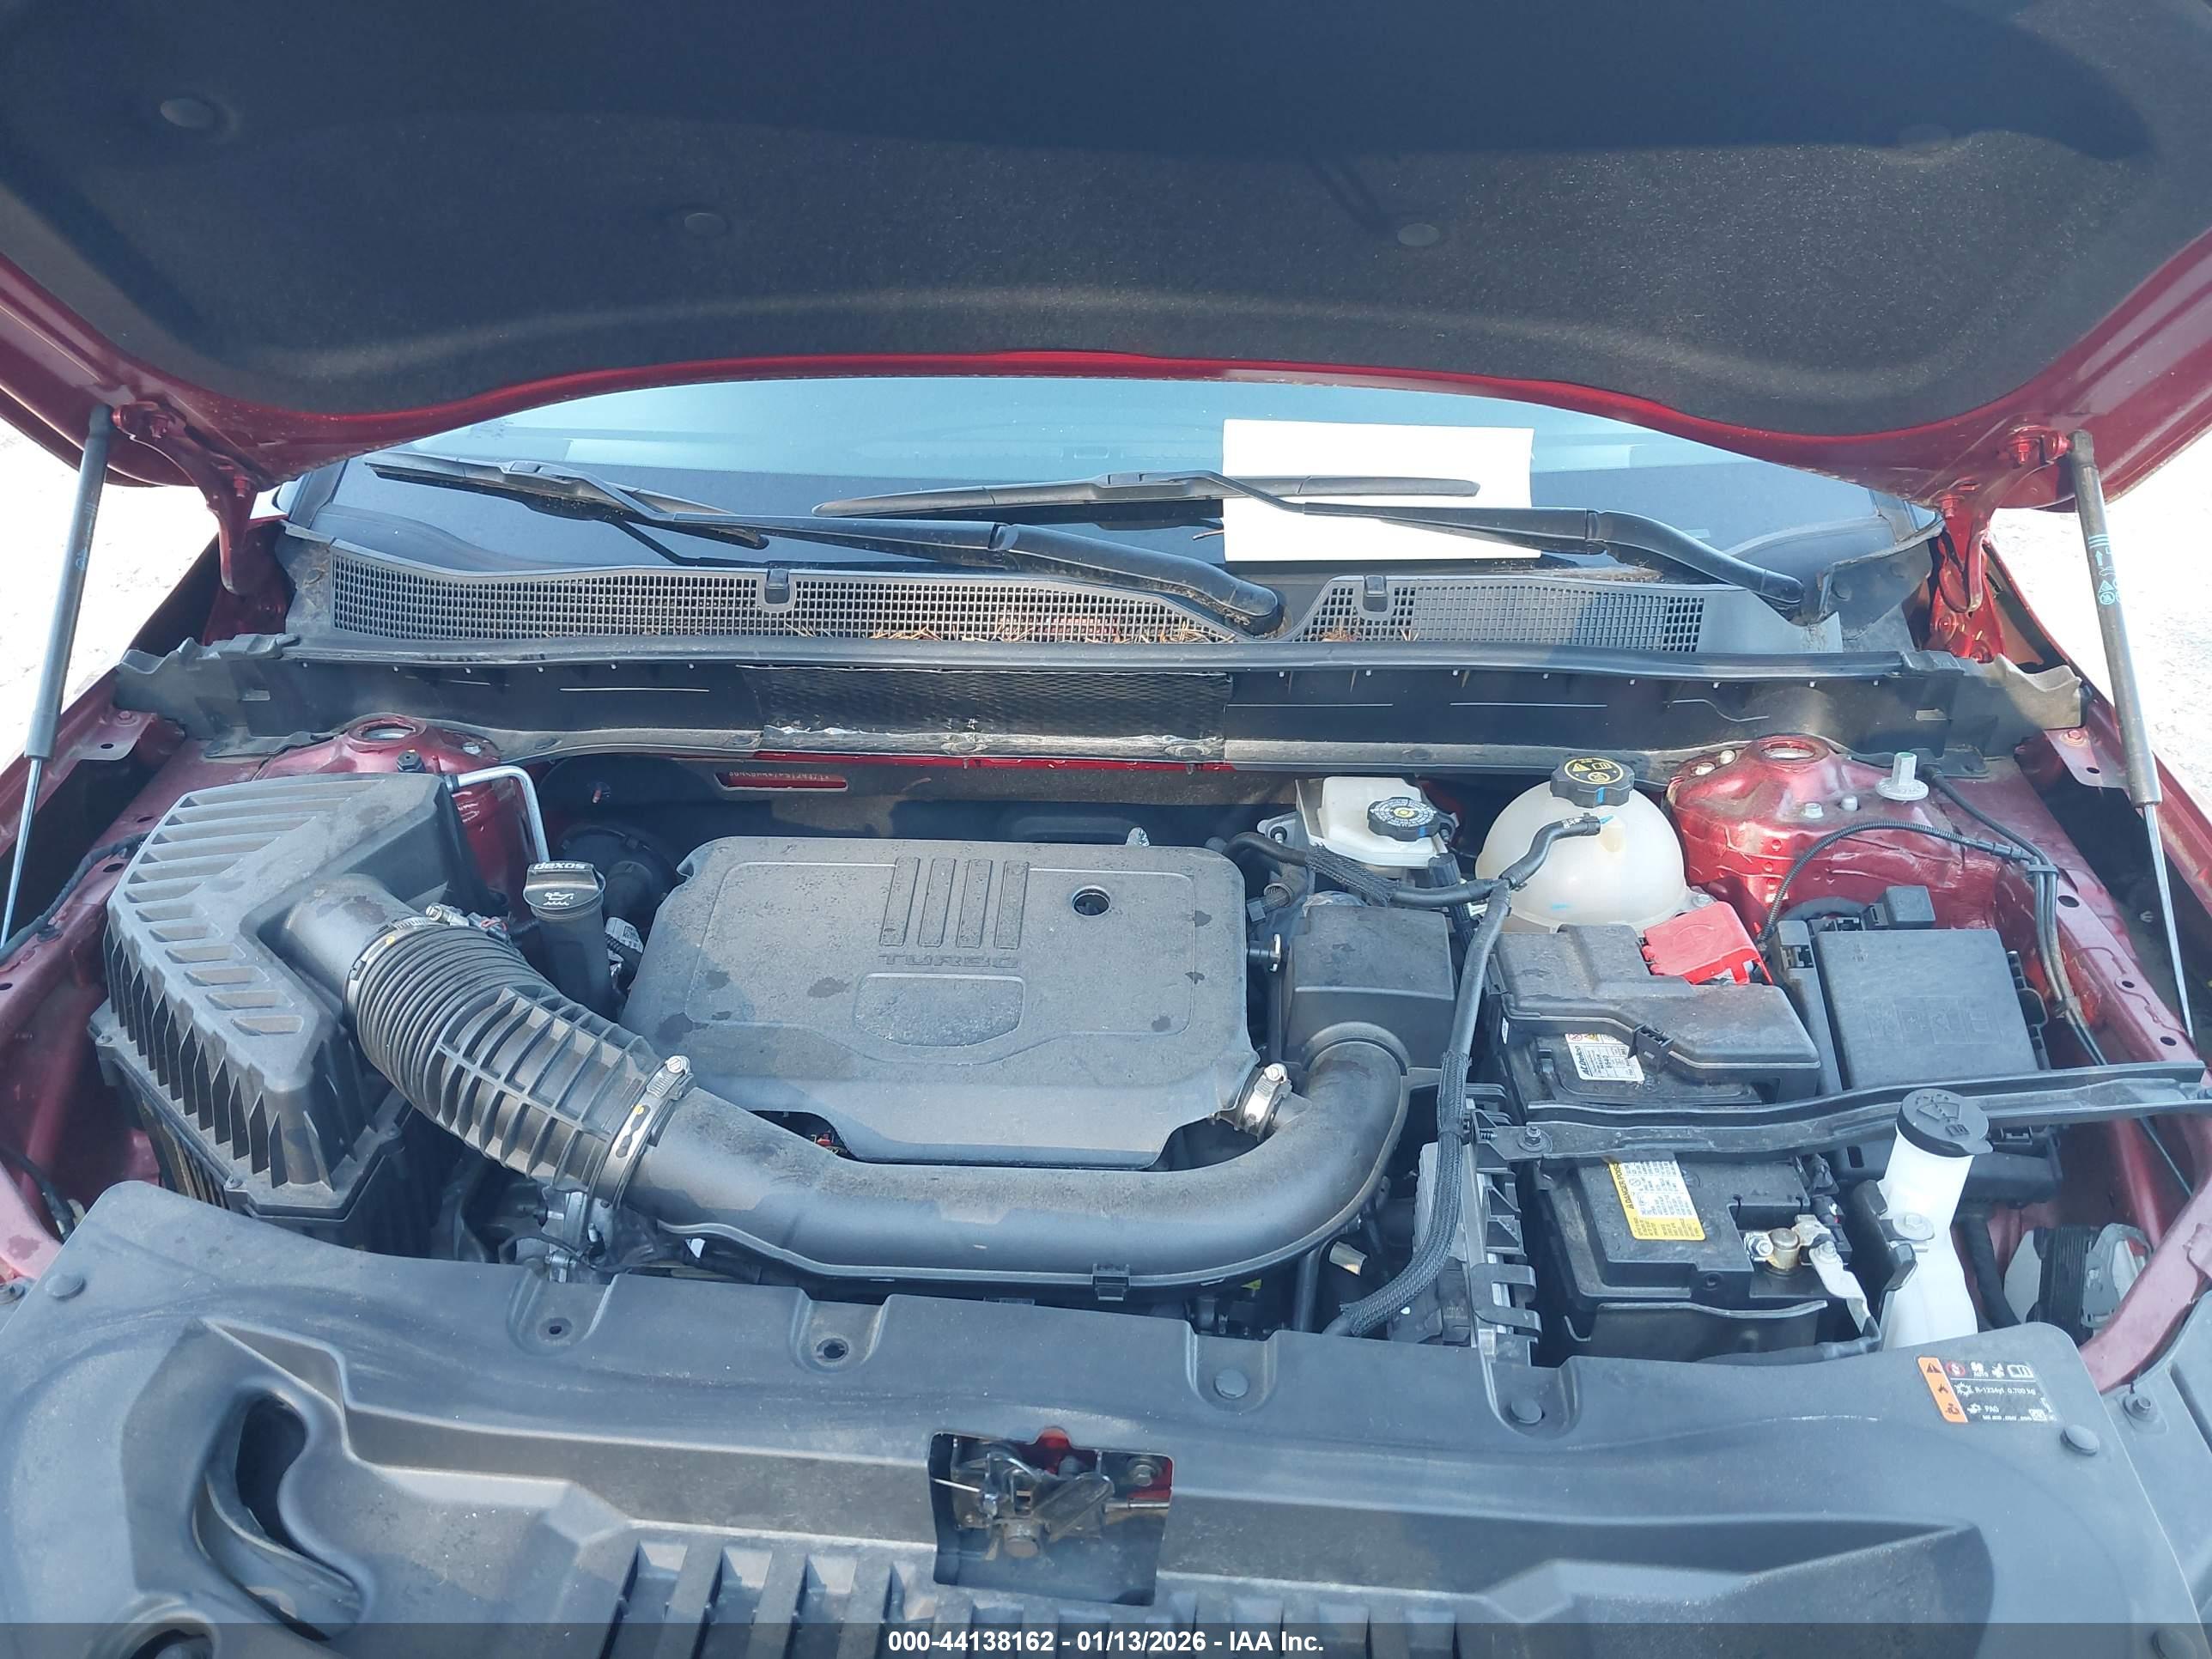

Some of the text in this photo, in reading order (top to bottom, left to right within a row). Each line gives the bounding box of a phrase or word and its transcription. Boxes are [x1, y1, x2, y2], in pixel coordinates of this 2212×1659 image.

[533, 861, 586, 870] dexos
[878, 953, 1019, 969] TURBO
[1574, 1045, 1590, 1076] ACDelco
[1618, 1179, 1633, 1204] DANGER
